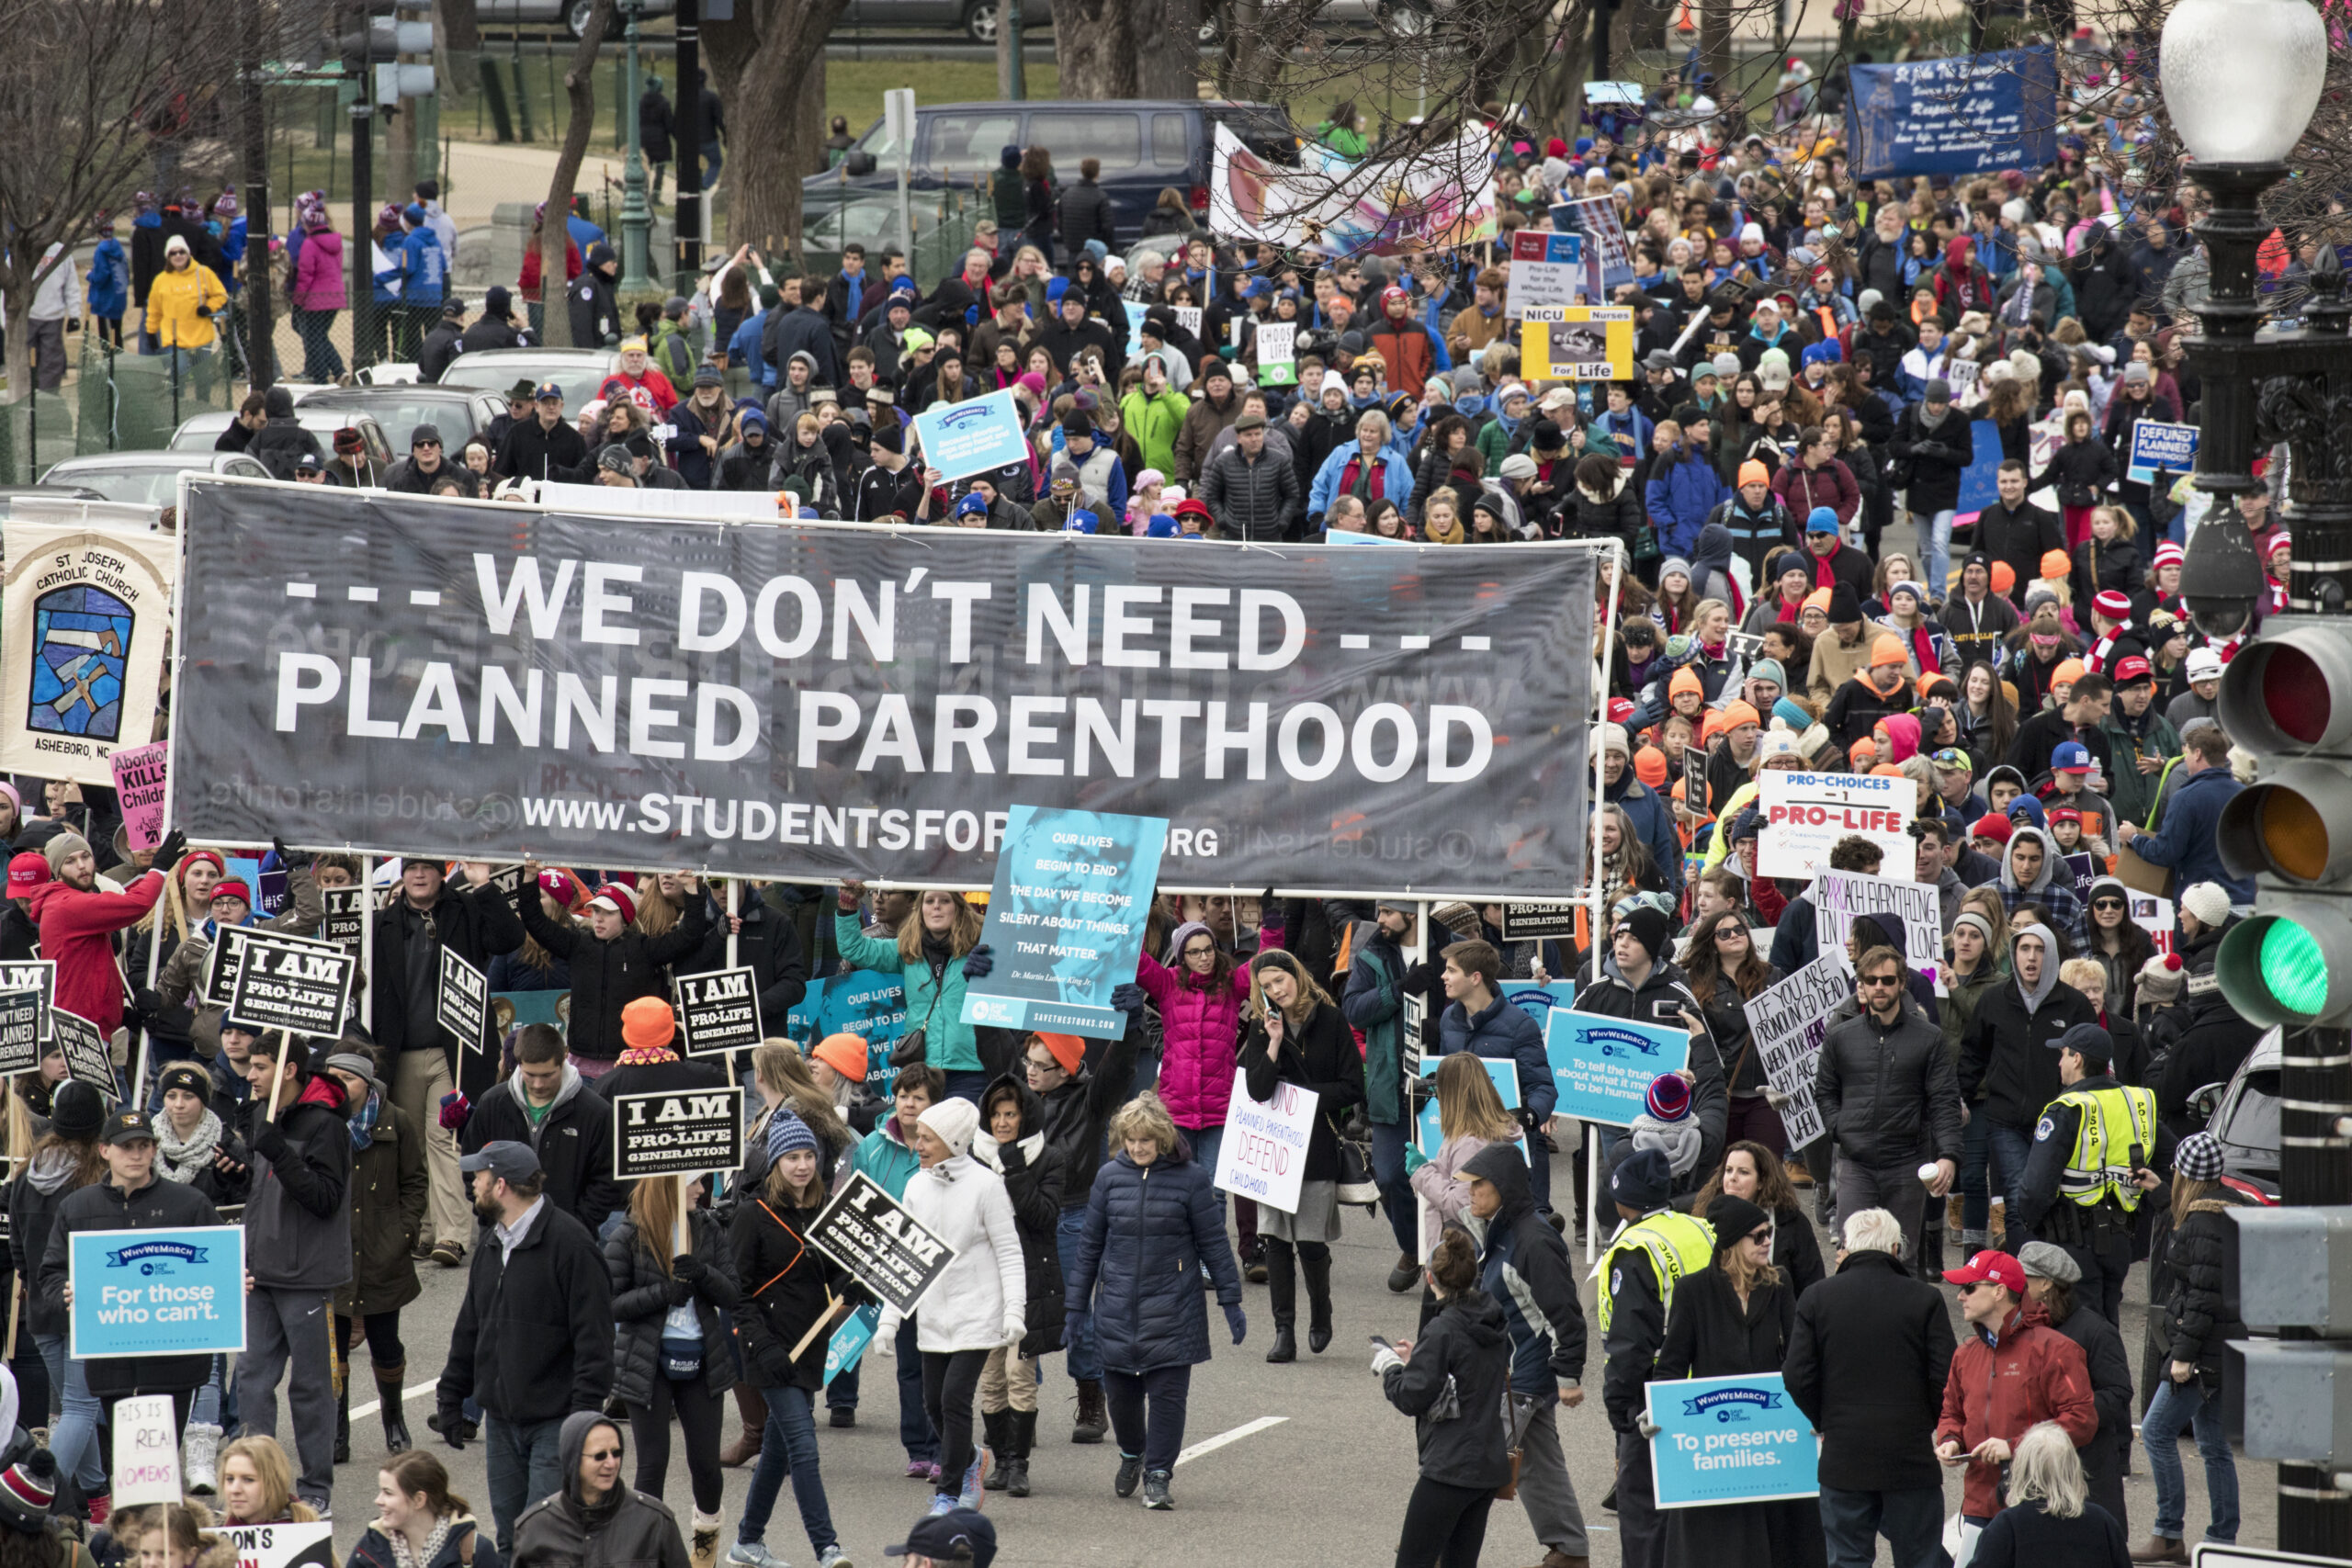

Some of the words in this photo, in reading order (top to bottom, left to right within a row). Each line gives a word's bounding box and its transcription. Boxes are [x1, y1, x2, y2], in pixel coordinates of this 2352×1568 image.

[1962, 98, 1995, 114] Life
[1526, 310, 1563, 321] NICU
[1592, 311, 1630, 320] Nurses
[1270, 344, 1288, 359] LIFE
[1554, 367, 1572, 375] For
[1578, 365, 1611, 377] Life
[2139, 426, 2192, 442] DEFUND
[2137, 439, 2191, 453] PLANNED
[55, 554, 71, 569] ST
[81, 551, 125, 575] JOSEPH
[36, 567, 88, 591] CATHOLIC
[96, 569, 140, 603] CHURCH
[473, 553, 643, 646] WE
[678, 567, 992, 663] DON'T
[1025, 583, 1306, 671] NEED
[276, 652, 760, 762] PLANNED
[797, 691, 1494, 783] PARENTHOOD
[34, 738, 92, 761] ASHEBORO,
[96, 745, 110, 759] NC
[1787, 774, 1891, 790] PRO-CHOICES
[1770, 806, 1902, 833] PRO-LIFE
[1052, 832, 1078, 845] OUR
[1080, 835, 1114, 848] LIVES
[1035, 859, 1071, 872] BEGIN
[1074, 863, 1091, 874] TO
[1091, 864, 1117, 876] END
[2075, 874, 2093, 889] ife
[331, 894, 343, 914] I
[1010, 885, 1032, 897] THE
[1034, 886, 1058, 899] DAY
[1059, 889, 1080, 902] WE
[1081, 892, 1133, 908] BECOME
[1818, 874, 1865, 913] APPROACH
[1868, 882, 1936, 924] EVERYTHING
[1509, 904, 1569, 915] PRO-LIFE
[999, 911, 1040, 925] SILENT
[1041, 917, 1083, 930] ABOUT
[1085, 920, 1129, 935] THINGS
[1509, 916, 1569, 927] GENERATION
[1820, 909, 1838, 944] IN
[1016, 942, 1047, 954] THAT
[1048, 945, 1099, 961] MATTER.
[1911, 924, 1939, 963] LOVE
[251, 948, 269, 973] I
[275, 953, 343, 984] AM
[445, 955, 454, 980] I
[455, 964, 482, 1002] AM
[685, 982, 699, 1005] I
[704, 974, 750, 1002] AM
[1012, 970, 1022, 979] Dr.
[1023, 971, 1044, 982] Martin
[1045, 973, 1066, 983] Luther
[1067, 976, 1083, 987] King
[1083, 977, 1092, 987] Jr.
[246, 981, 337, 1008] PRO-LIFE
[847, 993, 871, 1006] OUR
[872, 986, 901, 1000] LIVES
[1750, 994, 1770, 1024] IF
[1773, 976, 1802, 1009] YOU
[1804, 957, 1830, 993] ARE
[1816, 976, 1844, 1010] DEAD
[15, 1007, 35, 1022] NEED
[243, 998, 334, 1021] GENERATION
[444, 986, 481, 1023] PRO-LIFE
[690, 1007, 752, 1027] PRO-LIFE
[842, 1018, 874, 1033] BEGIN
[875, 1015, 891, 1027] TO
[892, 1012, 906, 1023] EN
[1034, 1012, 1115, 1030] SAVETHESTORKS.COM
[693, 1023, 753, 1041] GENERATION
[63, 1040, 107, 1071] PLANNED
[873, 1042, 890, 1054] WE
[1762, 1041, 1788, 1075] WHEN
[1786, 1032, 1808, 1061] YOUR
[1556, 1067, 1589, 1081] about
[1591, 1073, 1619, 1086] what
[1621, 1077, 1629, 1088] it
[1573, 1058, 1587, 1069] To
[1589, 1061, 1605, 1072] tell
[1607, 1065, 1625, 1077] the
[1627, 1068, 1655, 1081] truth
[1574, 1081, 1587, 1091] to
[1588, 1083, 1603, 1094] be
[1605, 1085, 1645, 1101] human.
[628, 1101, 646, 1125] I
[655, 1095, 731, 1122] AM
[1235, 1106, 1264, 1132] PLANNED
[1265, 1120, 1306, 1148] PARENTHOOD
[1787, 1108, 1819, 1145] WHEN
[2089, 1104, 2099, 1146] USCP
[2137, 1101, 2150, 1145] POLICE
[628, 1129, 731, 1149] PRO-LIFE
[628, 1145, 731, 1162] GENERATION
[1238, 1131, 1289, 1177] DEFEND
[1229, 1168, 1268, 1196] CHILDHOOD
[850, 1184, 878, 1213] I
[872, 1208, 945, 1268] AM
[834, 1211, 923, 1287] PRO-LIFE
[827, 1225, 912, 1297] GENERATION
[102, 1286, 142, 1305] For
[149, 1283, 215, 1303] those
[97, 1305, 149, 1325] who
[147, 1403, 162, 1417] IS
[1672, 1433, 1699, 1451] To
[1704, 1428, 1798, 1453] preserve
[1692, 1450, 1781, 1471] families.
